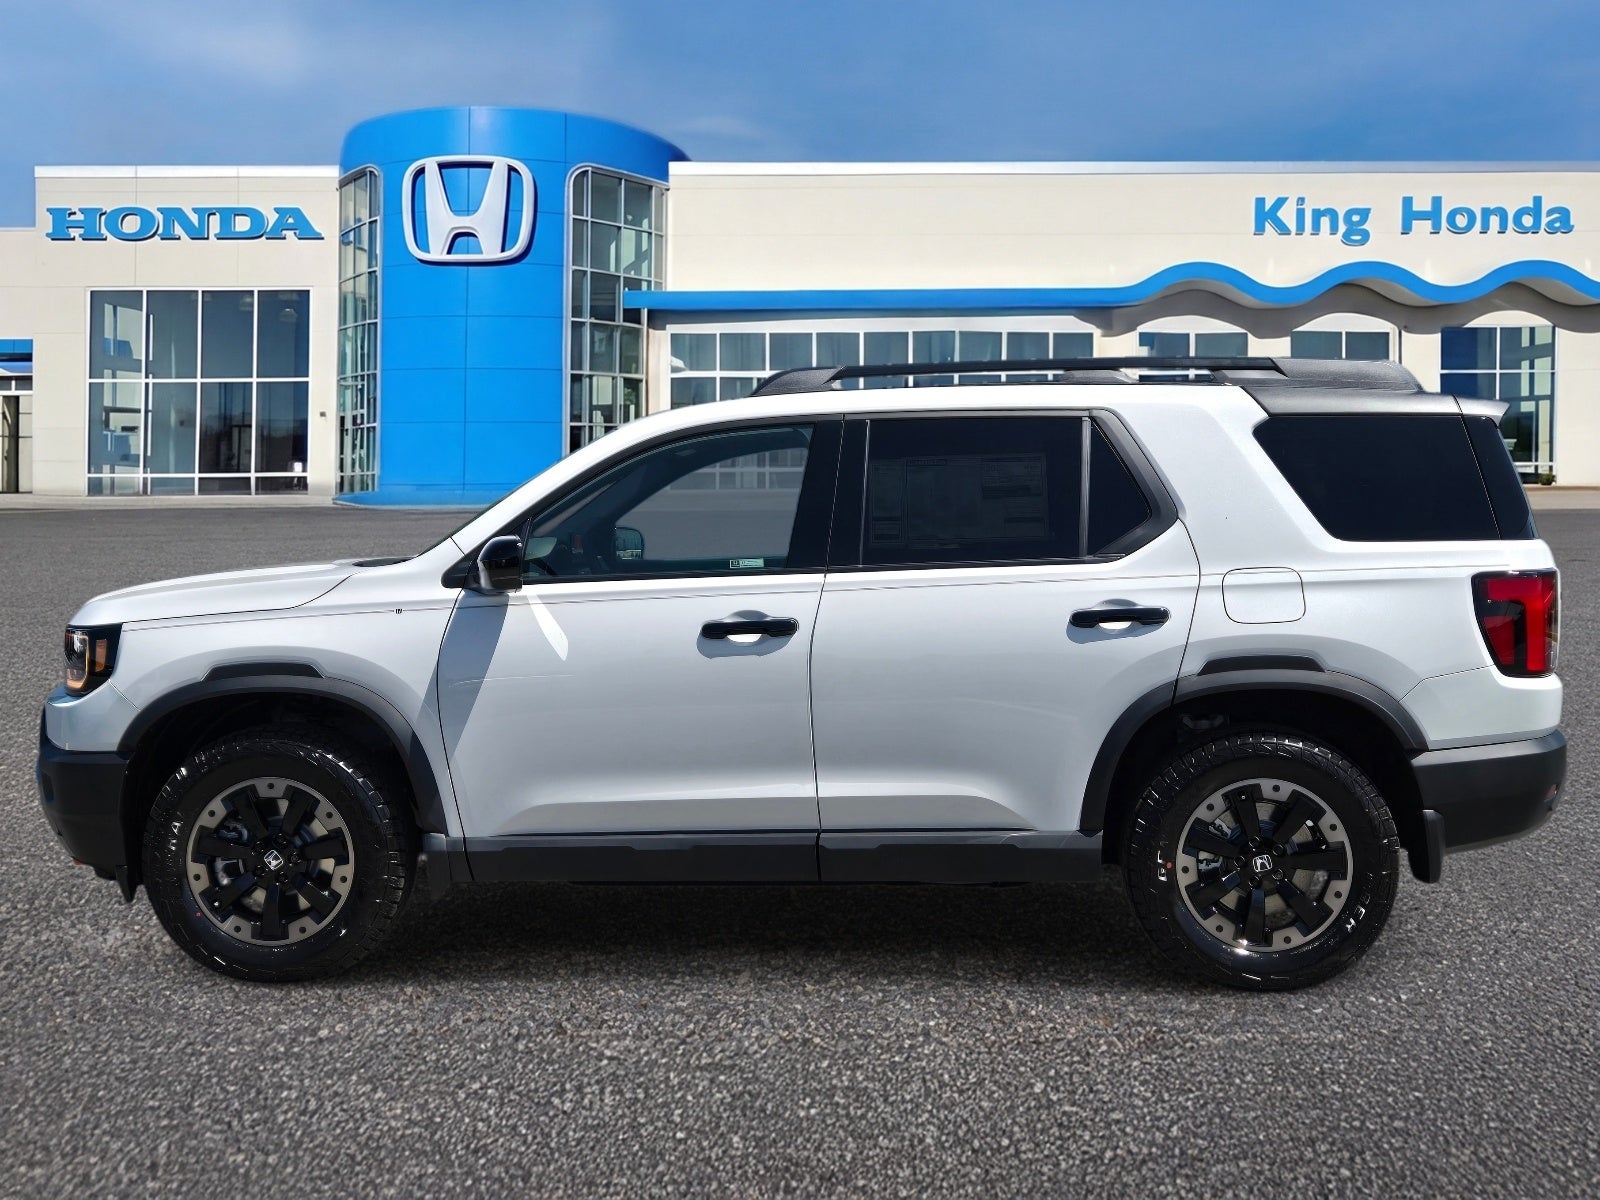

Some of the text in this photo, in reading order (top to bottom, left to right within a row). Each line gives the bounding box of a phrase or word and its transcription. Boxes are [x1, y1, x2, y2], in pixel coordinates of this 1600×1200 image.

[46, 206, 324, 241] HONDA
[1254, 196, 1574, 245] King Honda
